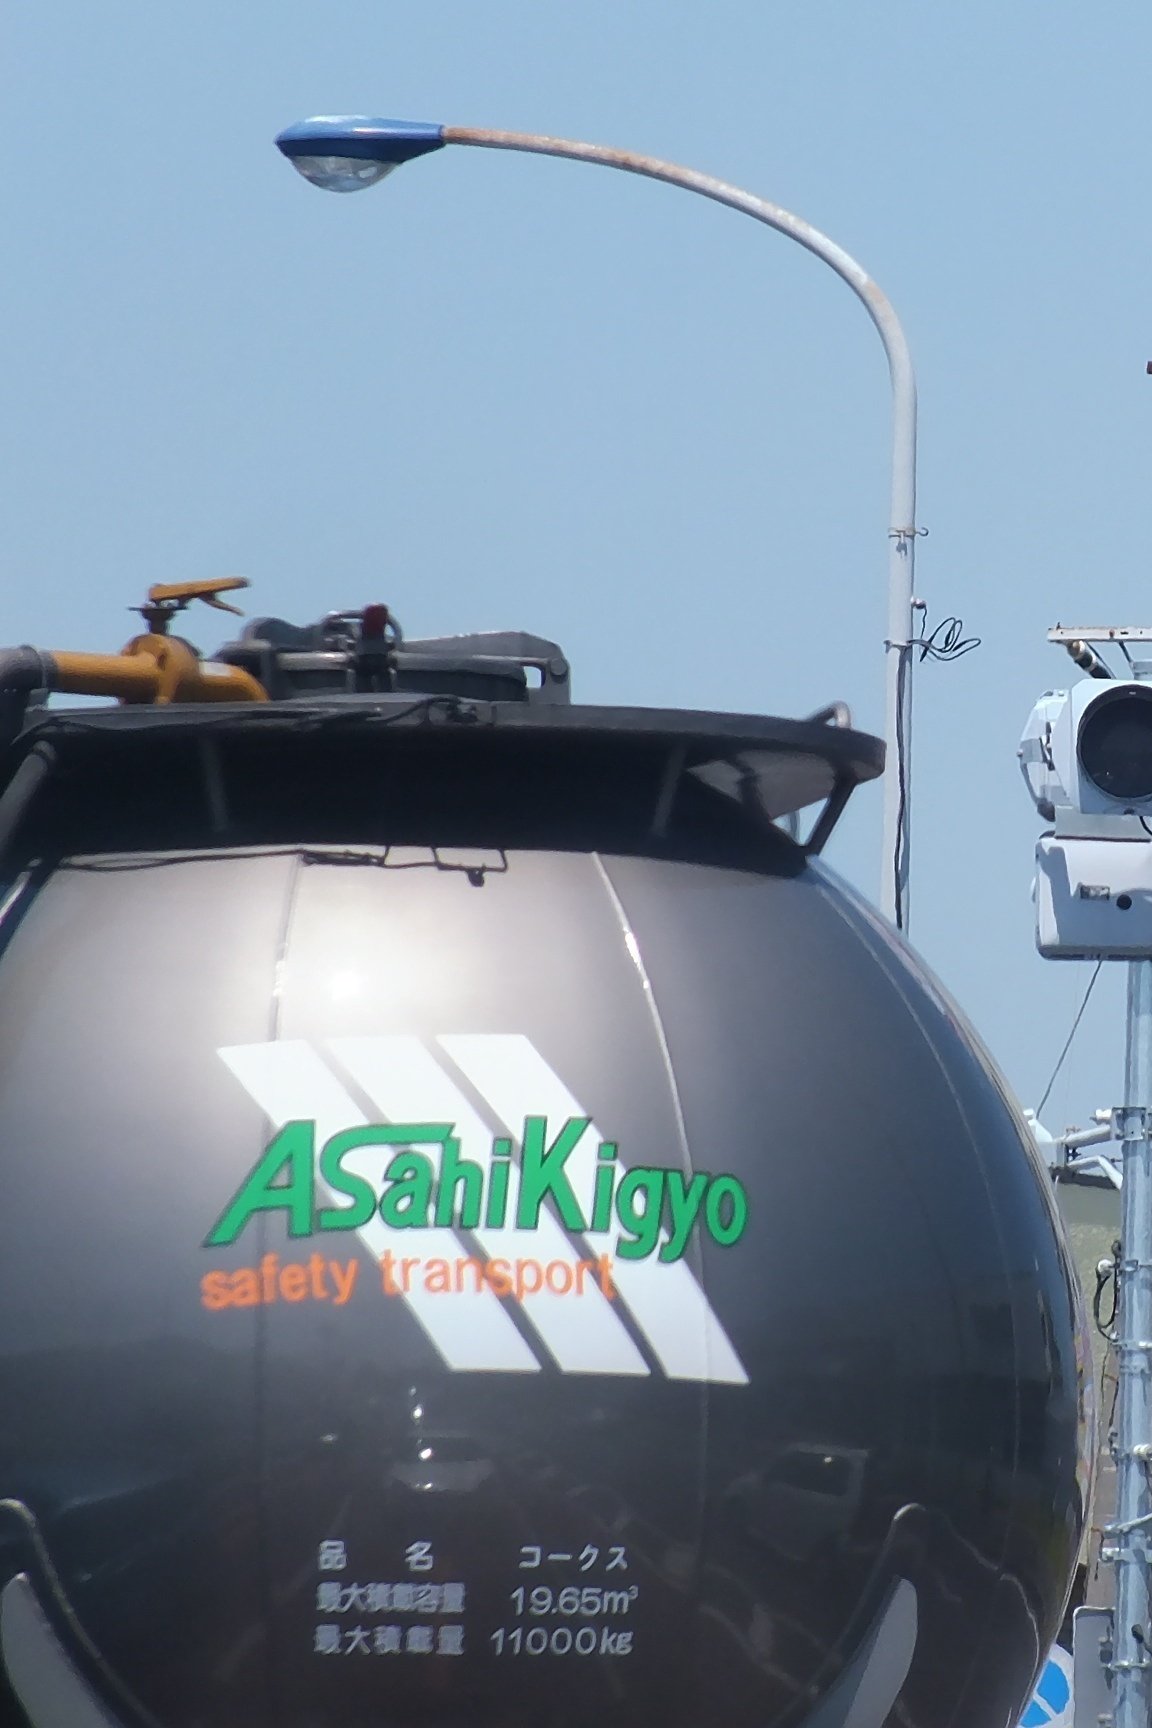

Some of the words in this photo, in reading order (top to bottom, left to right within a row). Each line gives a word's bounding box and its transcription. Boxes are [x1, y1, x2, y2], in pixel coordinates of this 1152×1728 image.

[200, 1252, 358, 1311] safety
[380, 1249, 618, 1302] transport
[518, 1543, 628, 1571] コークス
